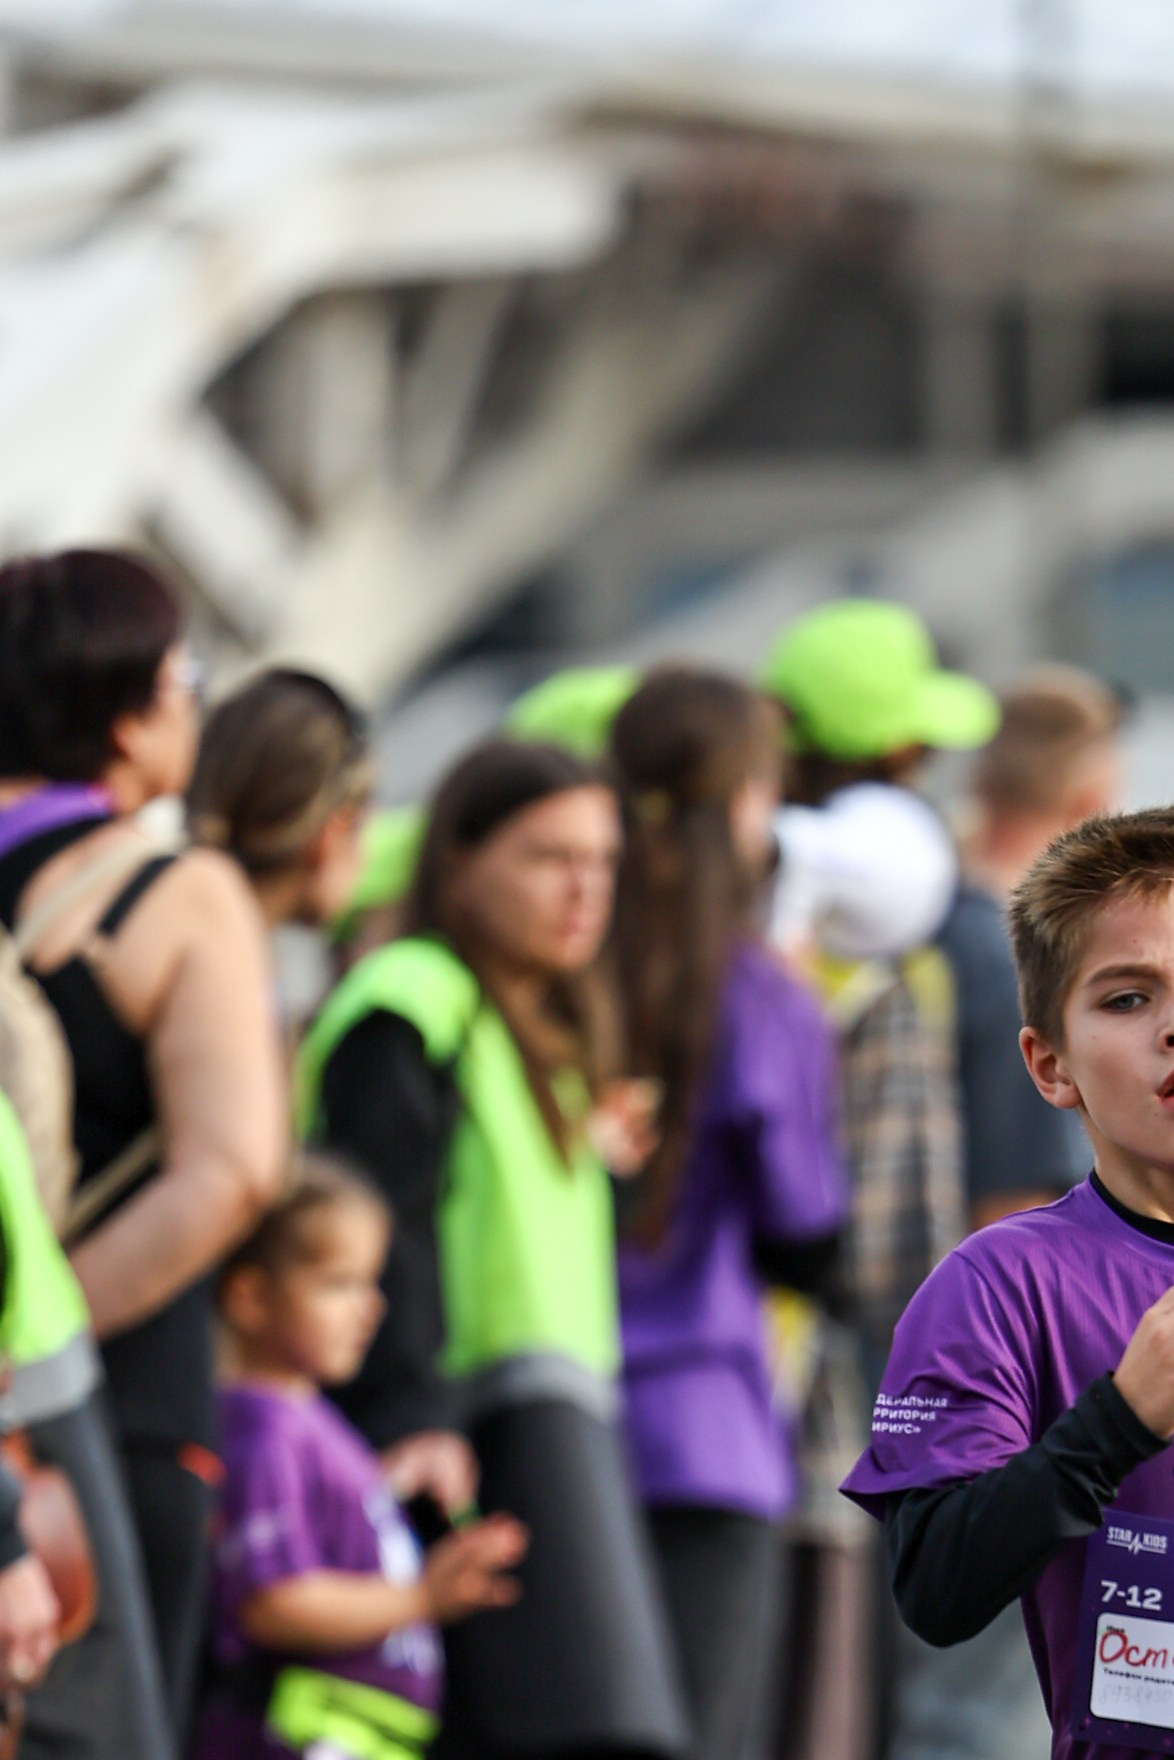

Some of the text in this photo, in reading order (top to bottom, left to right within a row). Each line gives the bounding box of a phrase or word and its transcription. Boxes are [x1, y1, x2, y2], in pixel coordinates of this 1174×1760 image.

[1106, 1526, 1168, 1549] STAR KIDS
[1100, 1580, 1163, 1611] 7-12
